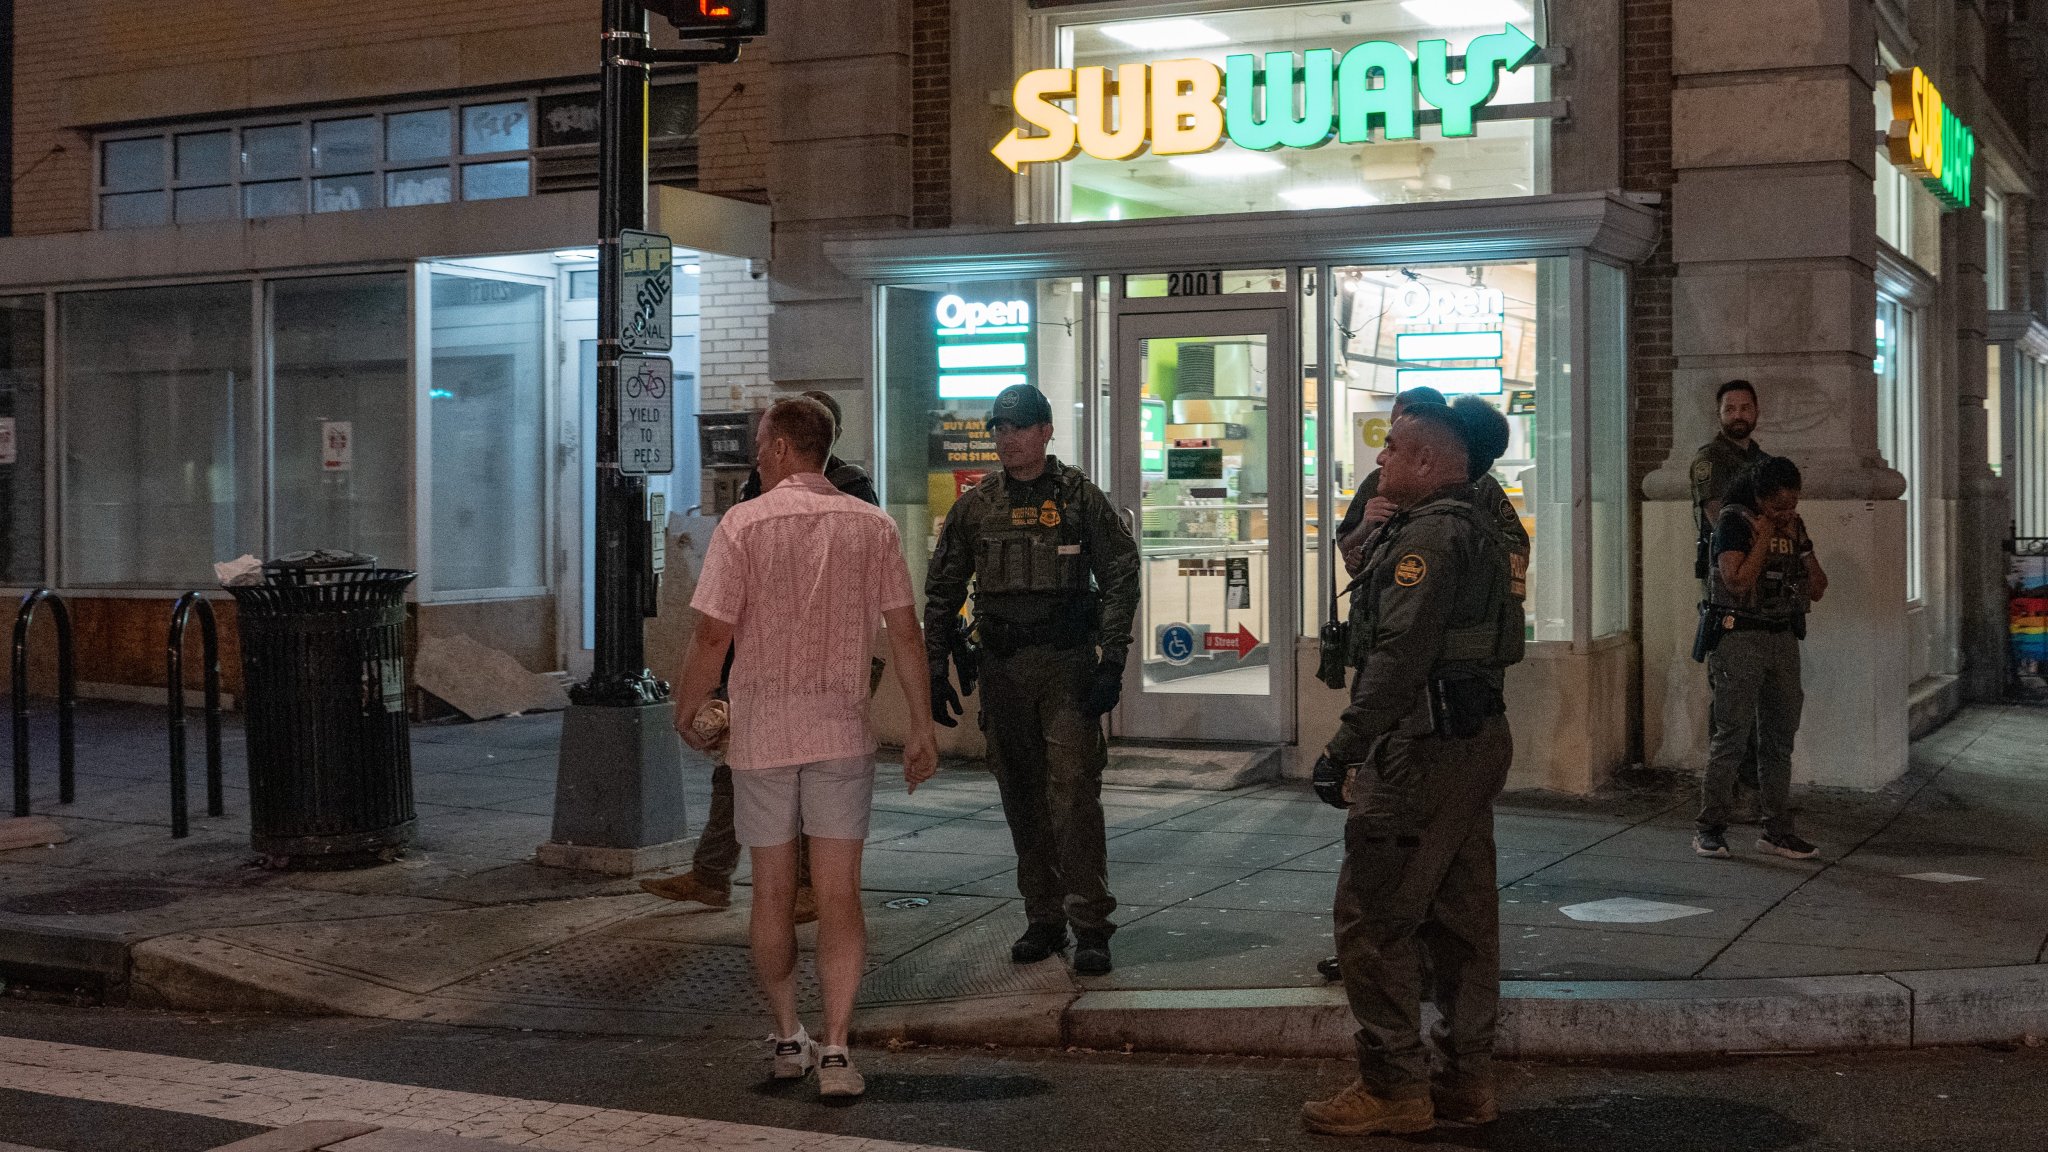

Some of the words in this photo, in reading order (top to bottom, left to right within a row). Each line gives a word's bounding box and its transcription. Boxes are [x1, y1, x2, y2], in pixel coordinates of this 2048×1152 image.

[990, 22, 1537, 174] SUBWAY
[1909, 66, 1975, 208] SUBWAY
[1168, 272, 1221, 296] 2001
[1400, 280, 1504, 326] Open
[936, 294, 1029, 335] Open
[629, 407, 660, 422] YIELD
[640, 428, 652, 442] TO
[948, 452, 968, 461] FOR
[981, 452, 1000, 461] MO
[1770, 538, 1794, 555] FBI
[1214, 636, 1240, 648] Street
